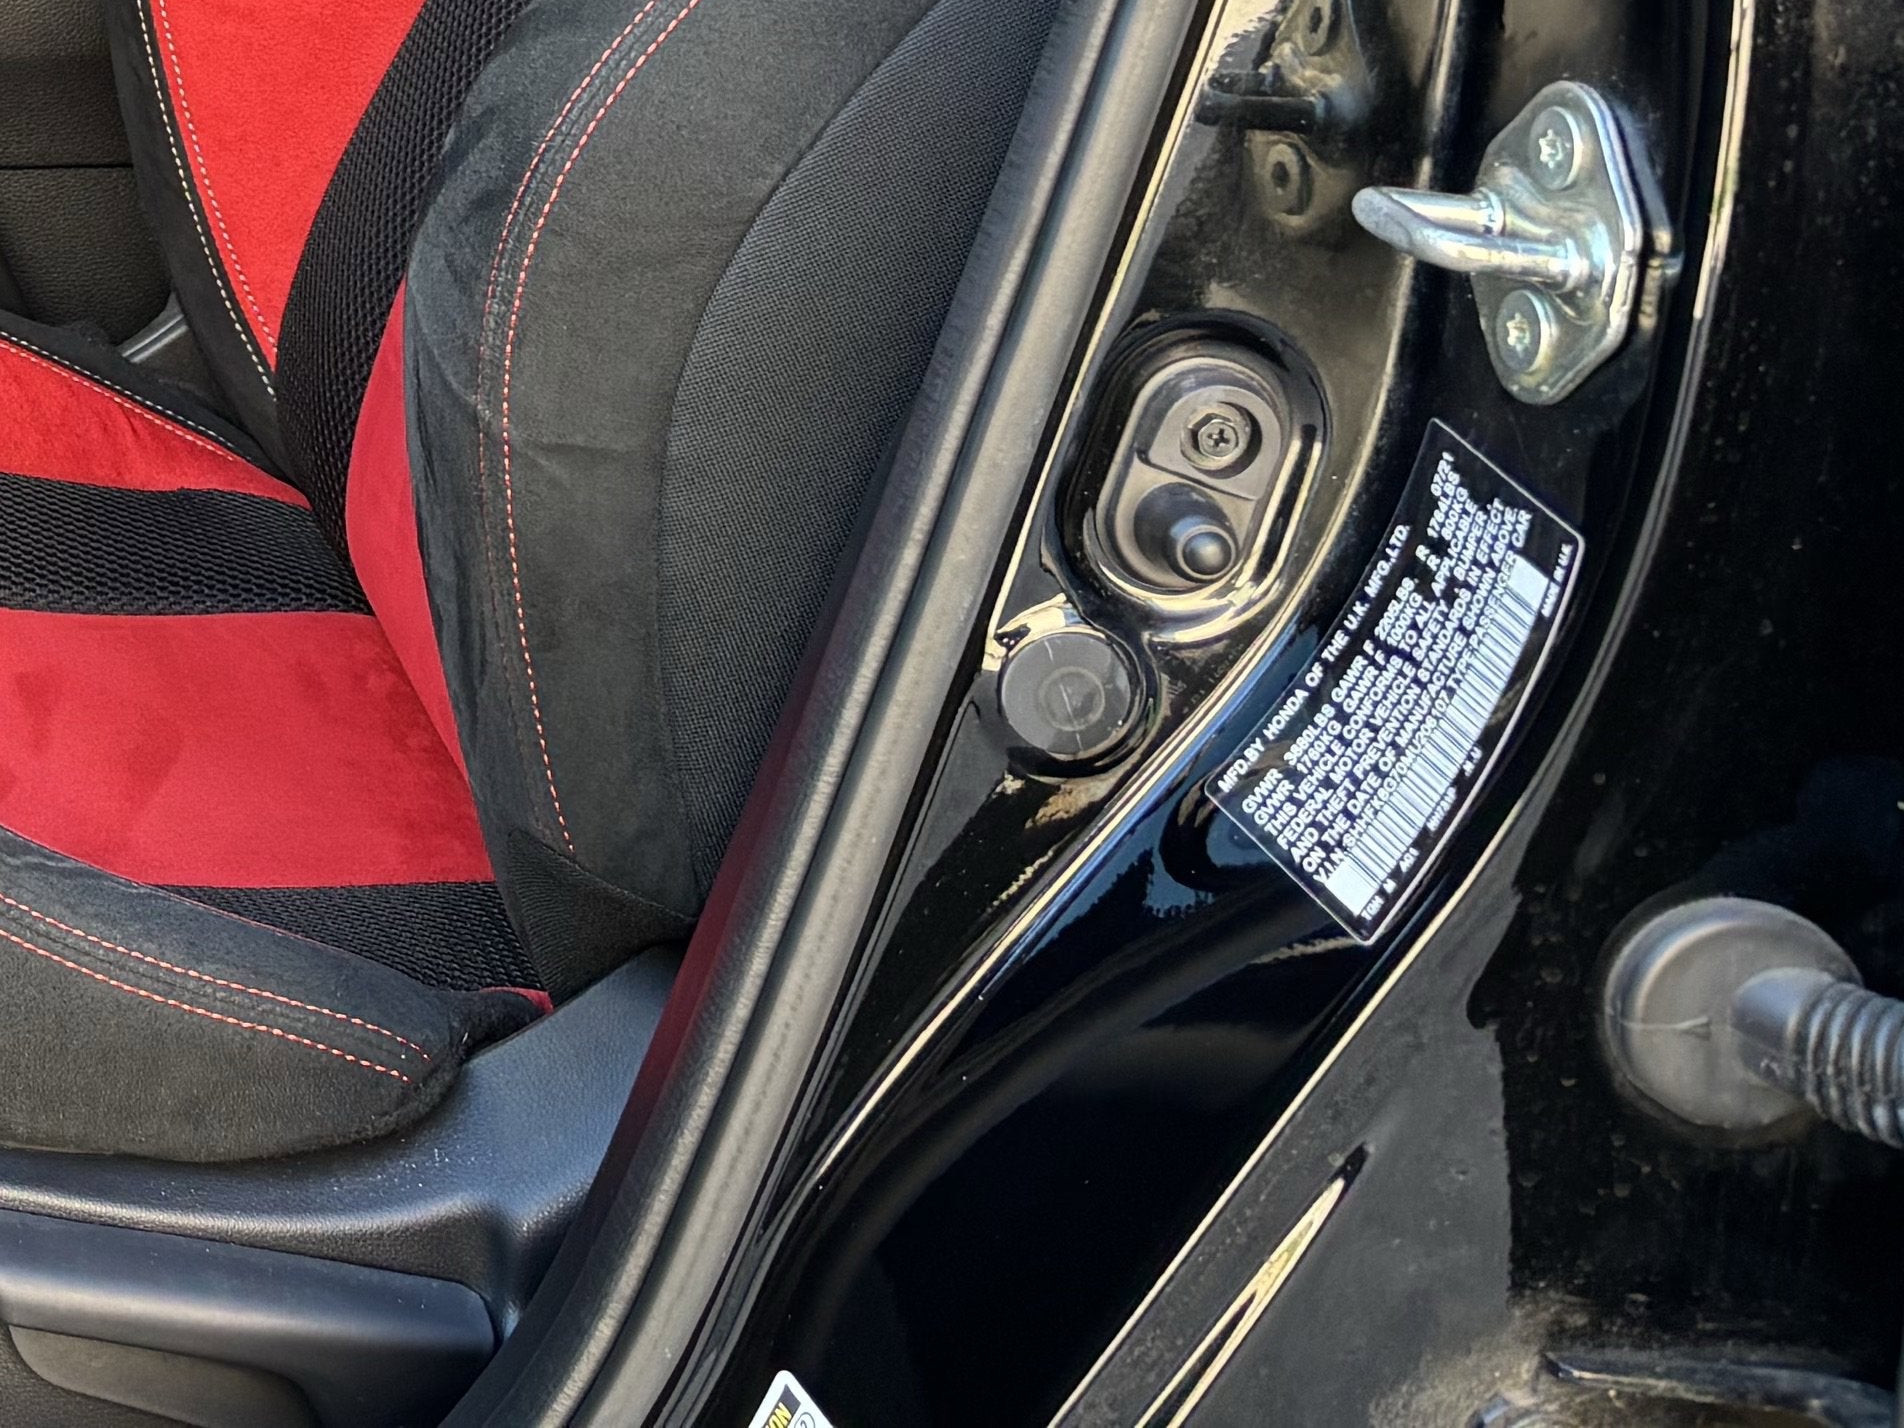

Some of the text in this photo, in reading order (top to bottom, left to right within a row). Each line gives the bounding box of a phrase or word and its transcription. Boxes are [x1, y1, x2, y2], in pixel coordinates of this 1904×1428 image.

[1511, 509, 1531, 547] CAR
[1241, 768, 1283, 813] GVWR
[1331, 655, 1368, 702] GAWR
[1362, 639, 1374, 655] F
[1415, 544, 1430, 561] R
[1253, 779, 1295, 825] GVWR
[1342, 665, 1379, 713] GAWR
[1374, 649, 1385, 665] F
[1386, 588, 1422, 646] 1000KG
[1426, 554, 1440, 571] R
[1262, 688, 1309, 740] HONDA
[1304, 661, 1323, 687] OF
[1320, 629, 1349, 661] THE
[1343, 600, 1369, 630] U.K.
[1263, 496, 1478, 836] THIS VEHICLE CONFORMS TO ALL APPLICABLE
[1276, 786, 1334, 850] FEDERAL
[1328, 727, 1374, 784] MOTOR
[1368, 661, 1416, 726] VEHICLE
[1290, 497, 1506, 863] AND THEFT PREVENTION STANDARDS IN EFFECT
[1302, 845, 1326, 872] ON
[1320, 813, 1351, 845] THE
[1346, 771, 1381, 815] DATE
[1378, 745, 1396, 772] OF
[1394, 630, 1467, 750] MANUFACTURE
[1462, 566, 1496, 630] SHOWN
